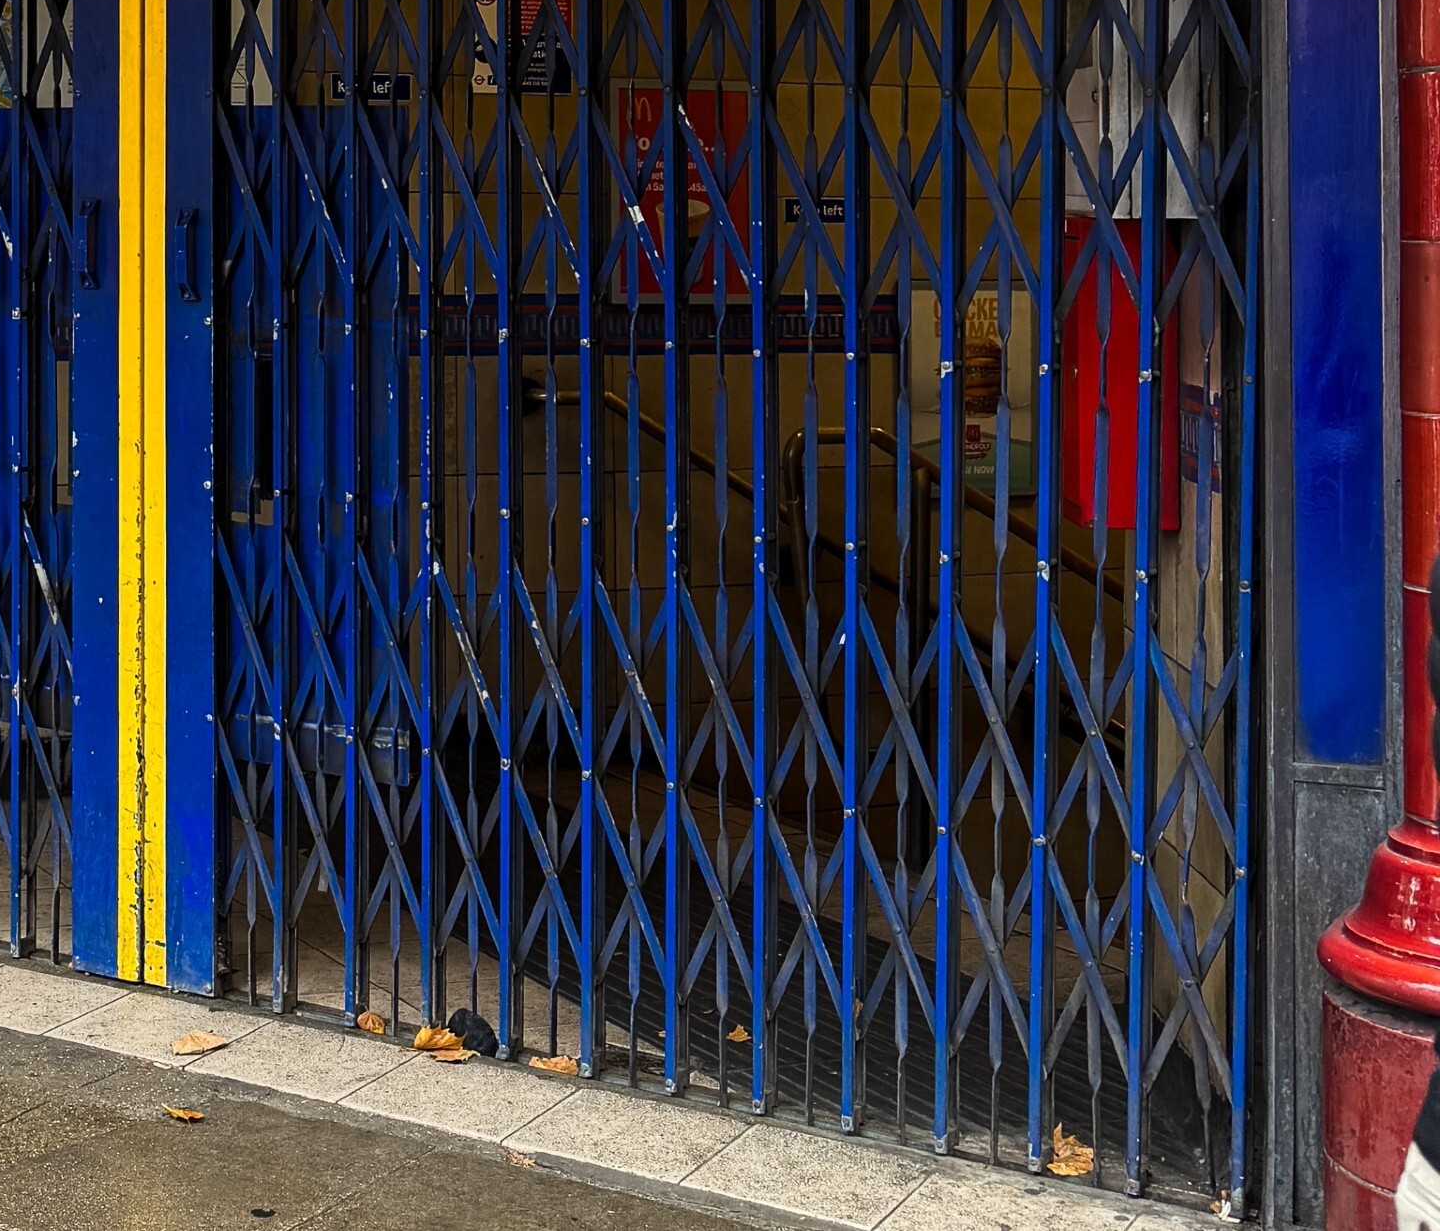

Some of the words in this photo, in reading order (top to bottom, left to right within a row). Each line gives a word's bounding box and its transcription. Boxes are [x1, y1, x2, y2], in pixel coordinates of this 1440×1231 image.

[373, 81, 393, 94] lef
[823, 204, 844, 216] left
[968, 321, 998, 338] MA
